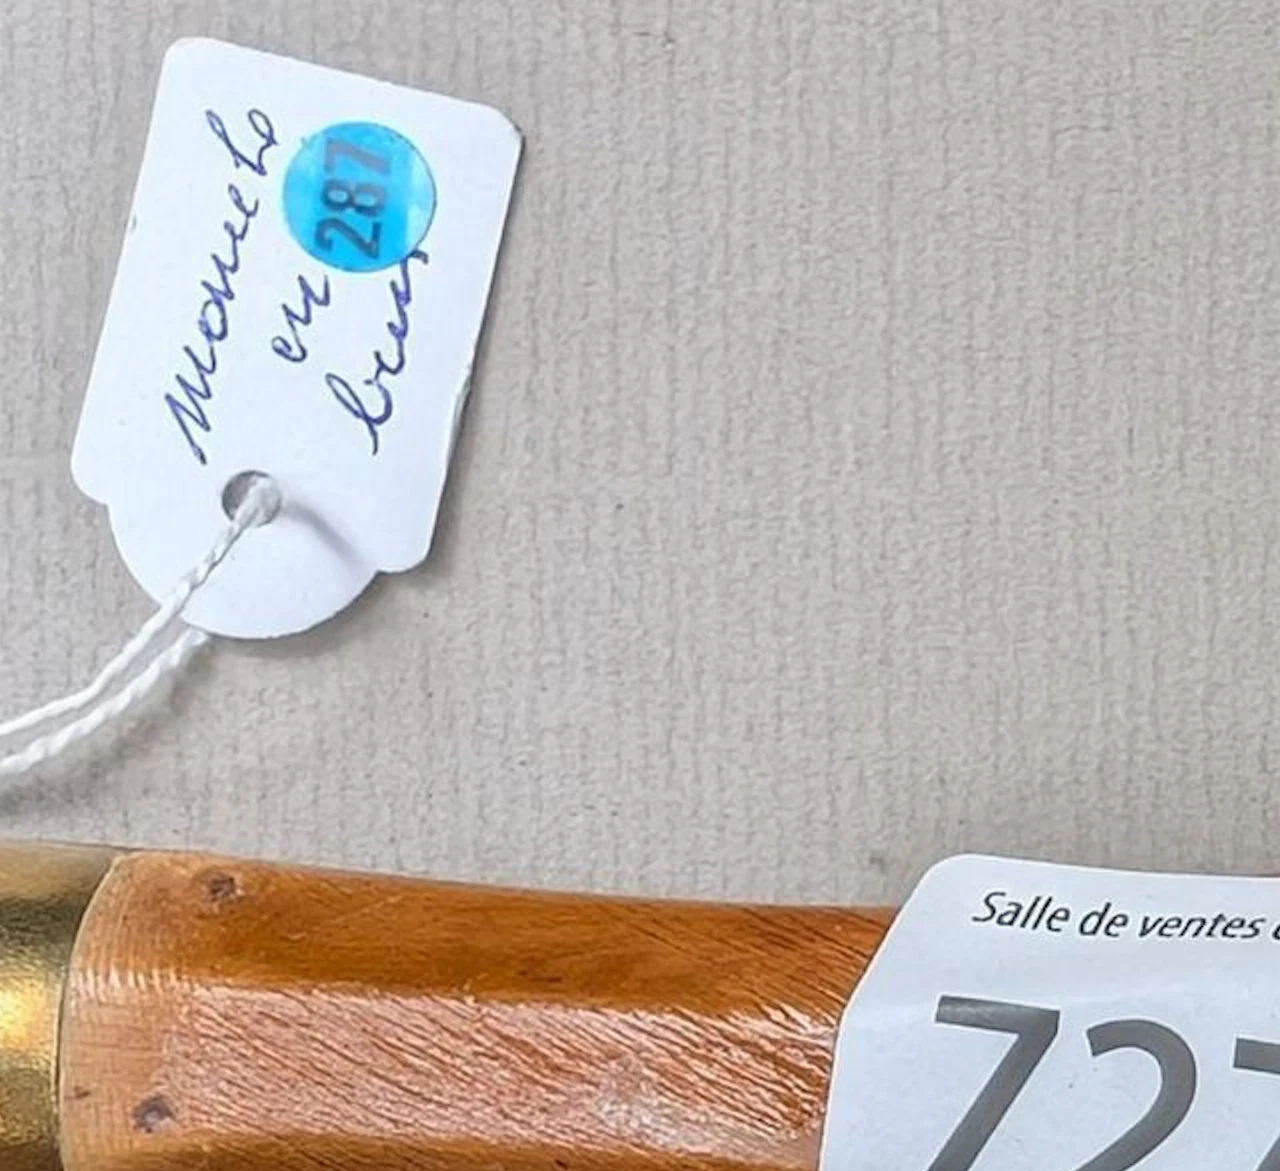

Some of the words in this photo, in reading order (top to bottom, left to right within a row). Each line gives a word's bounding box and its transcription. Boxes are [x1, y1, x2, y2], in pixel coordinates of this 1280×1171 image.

[314, 136, 391, 260] 287
[972, 891, 1071, 933] Salle
[1078, 902, 1129, 938] de
[1138, 912, 1267, 940] ventes
